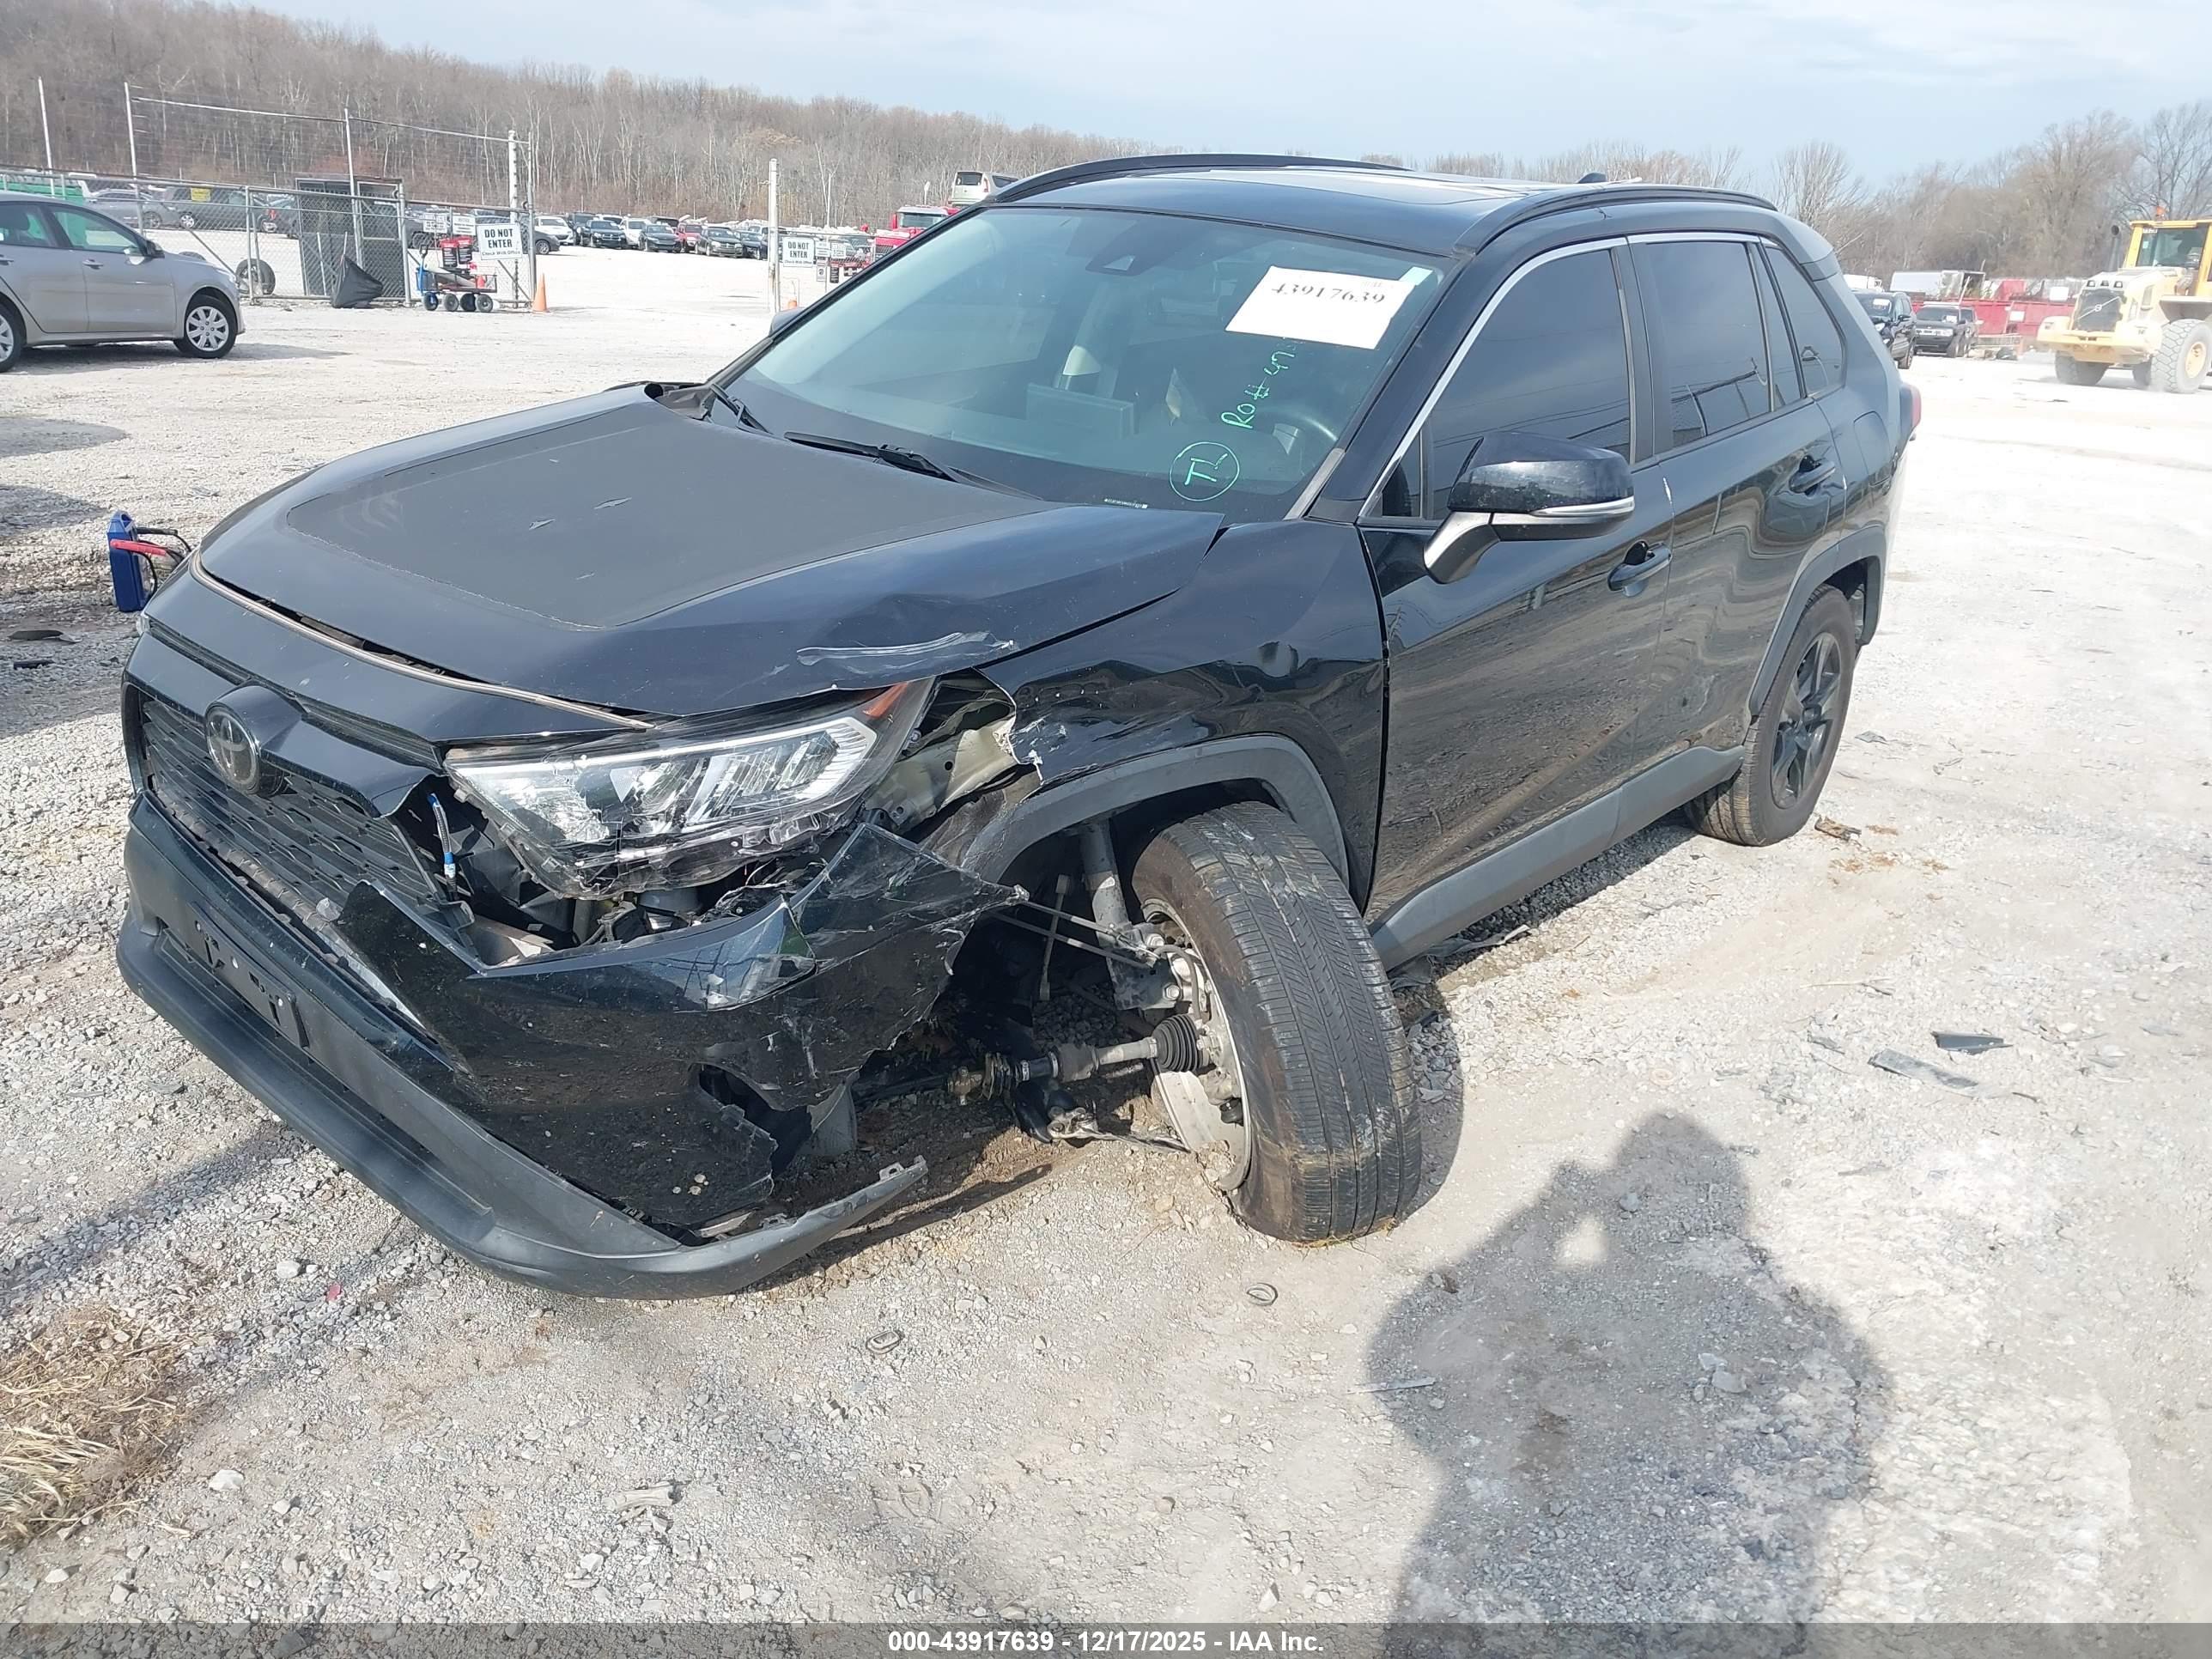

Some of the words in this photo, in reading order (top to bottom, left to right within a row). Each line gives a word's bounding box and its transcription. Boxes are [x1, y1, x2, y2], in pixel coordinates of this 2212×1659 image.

[484, 229, 495, 238] DO
[497, 228, 513, 237] NOT
[488, 239, 513, 248] ENTER
[789, 250, 808, 258] ENTER
[1270, 283, 1386, 304] 43917639
